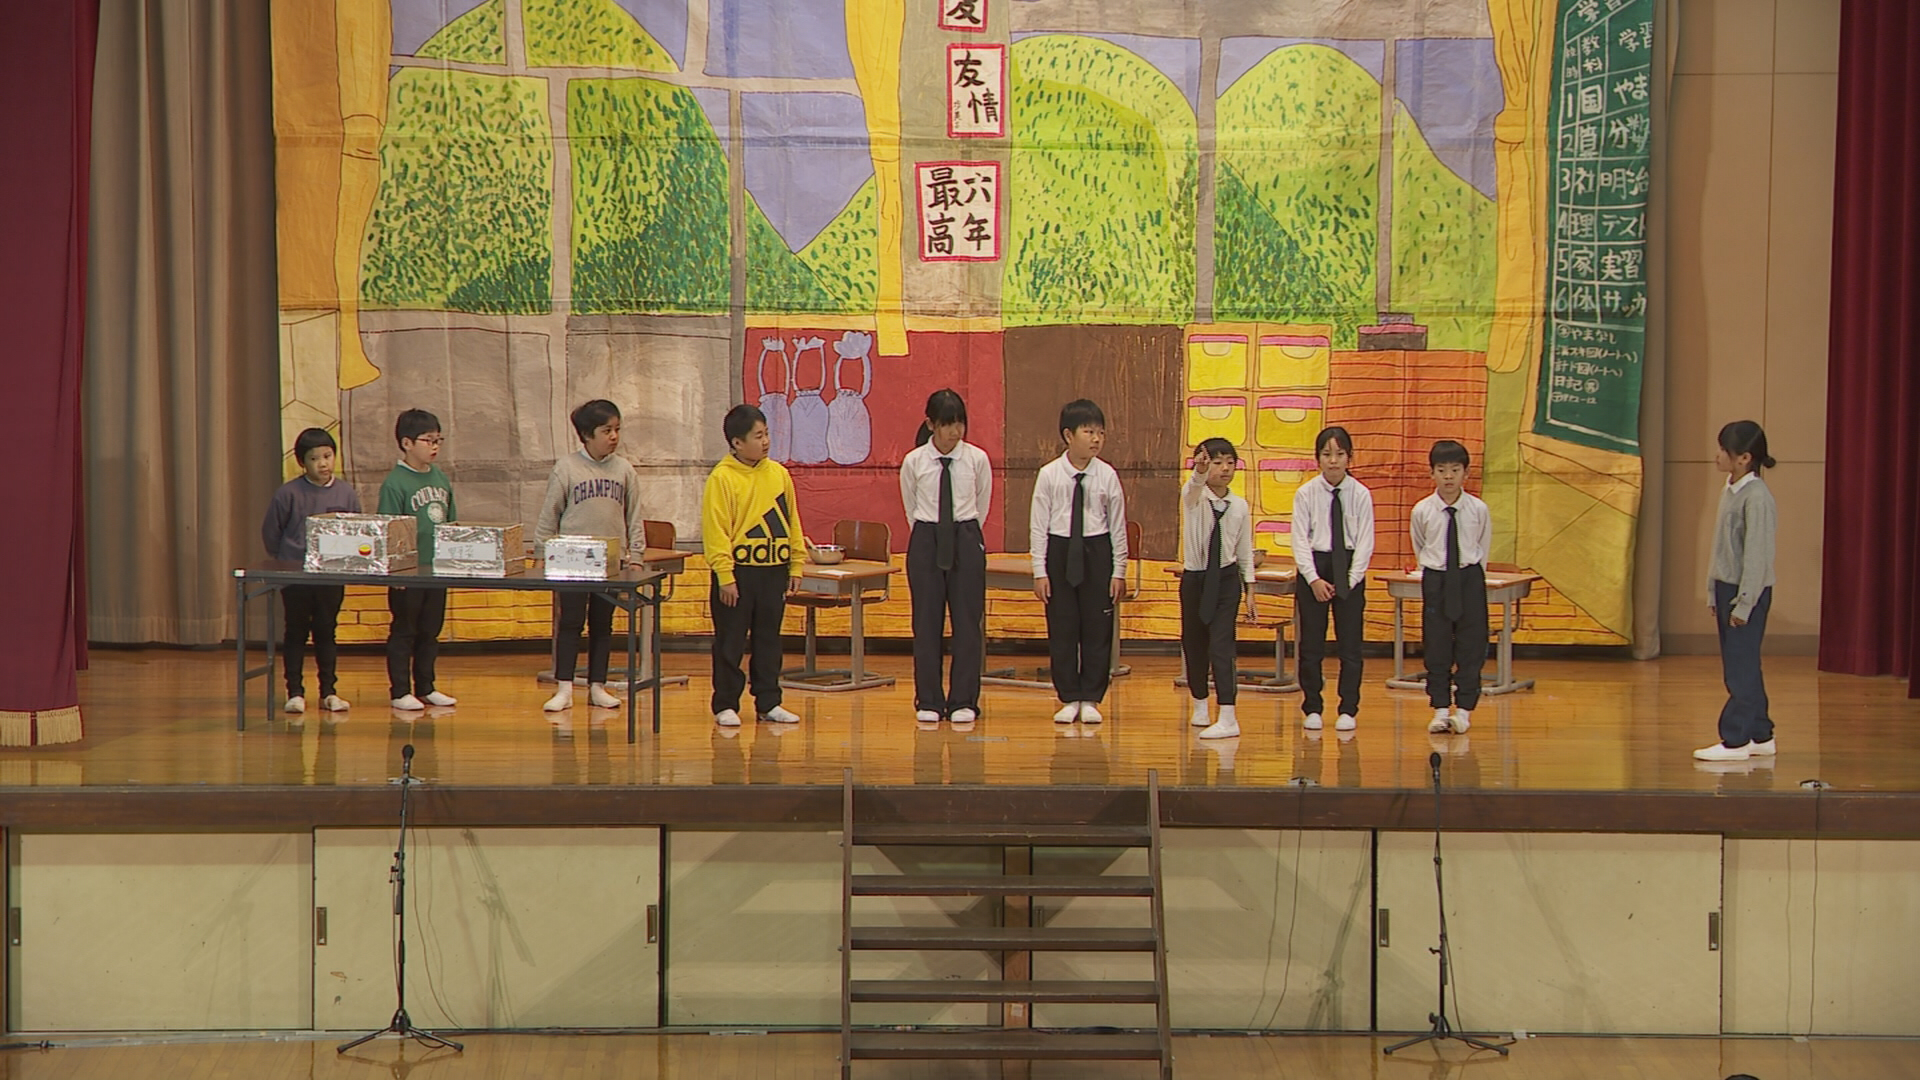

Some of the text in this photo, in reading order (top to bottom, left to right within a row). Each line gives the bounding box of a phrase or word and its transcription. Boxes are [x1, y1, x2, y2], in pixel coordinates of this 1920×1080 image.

[954, 50, 999, 124] 友情
[1581, 84, 1603, 114] 国
[1614, 72, 1650, 105] やま
[1562, 134, 1574, 152] 2
[1560, 166, 1650, 200] 3 社 明治
[927, 167, 964, 255] 最高
[962, 172, 992, 251] 六年
[1558, 211, 1646, 238] 4 理 テスト
[1558, 245, 1644, 281] 5 家 実習
[1556, 287, 1568, 312] 6
[1572, 286, 1595, 313] 体
